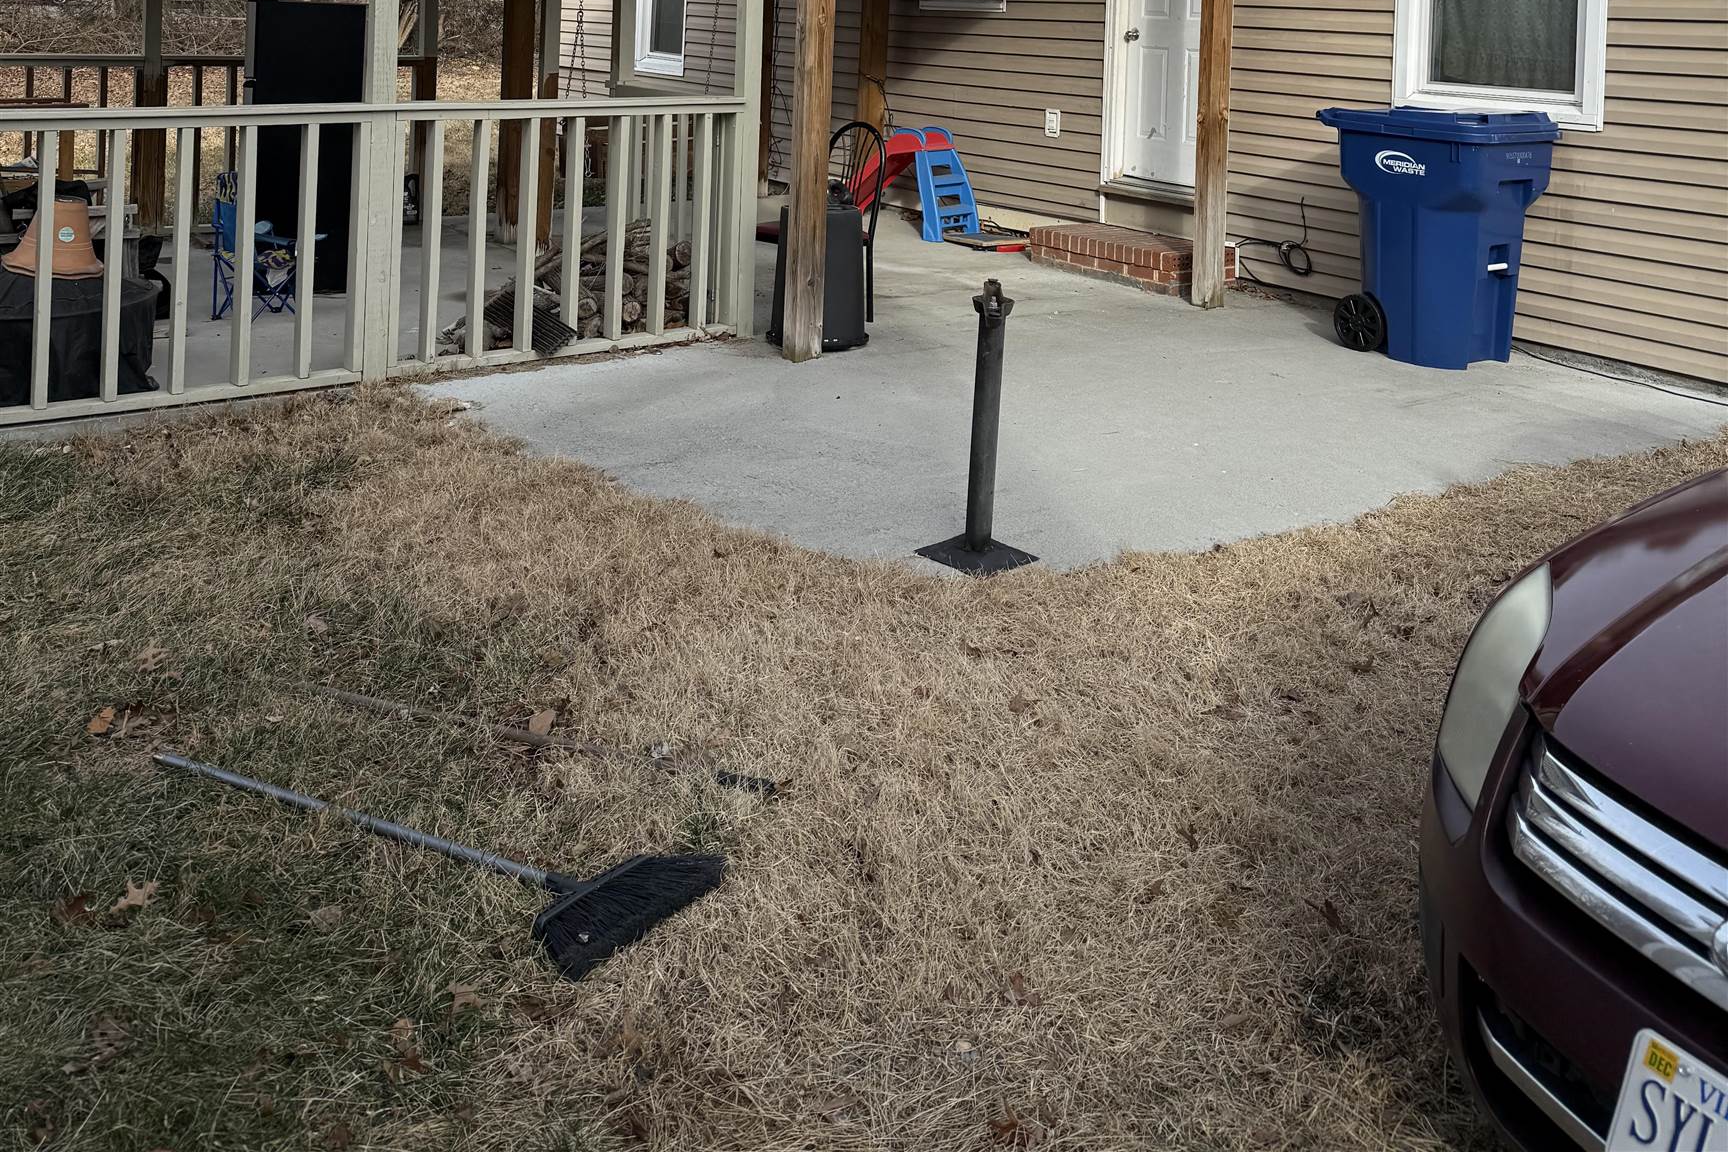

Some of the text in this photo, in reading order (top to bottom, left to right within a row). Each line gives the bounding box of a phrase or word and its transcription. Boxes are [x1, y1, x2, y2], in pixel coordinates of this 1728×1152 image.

[1382, 158, 1426, 170] MERIDIAN
[1393, 166, 1426, 177] WASTE
[1648, 1051, 1673, 1077] DEC
[1699, 1077, 1728, 1121] VI
